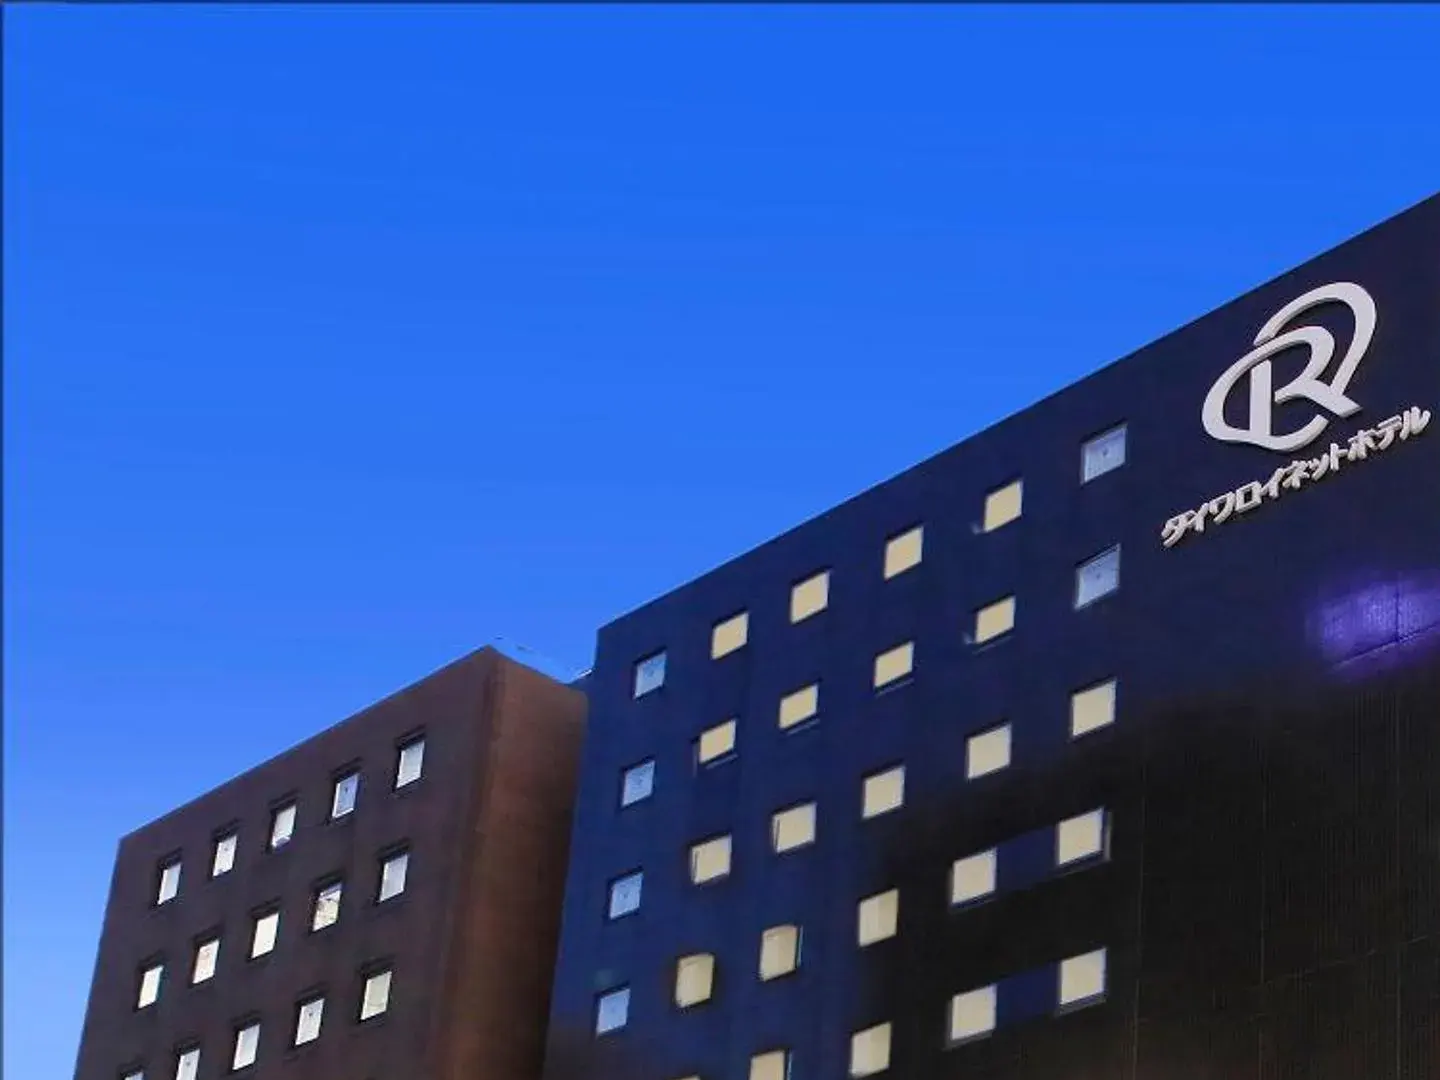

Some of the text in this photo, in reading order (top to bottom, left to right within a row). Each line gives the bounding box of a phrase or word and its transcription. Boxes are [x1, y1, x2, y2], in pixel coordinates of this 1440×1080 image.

[1160, 406, 1431, 549] ダイワロイネットホテル
